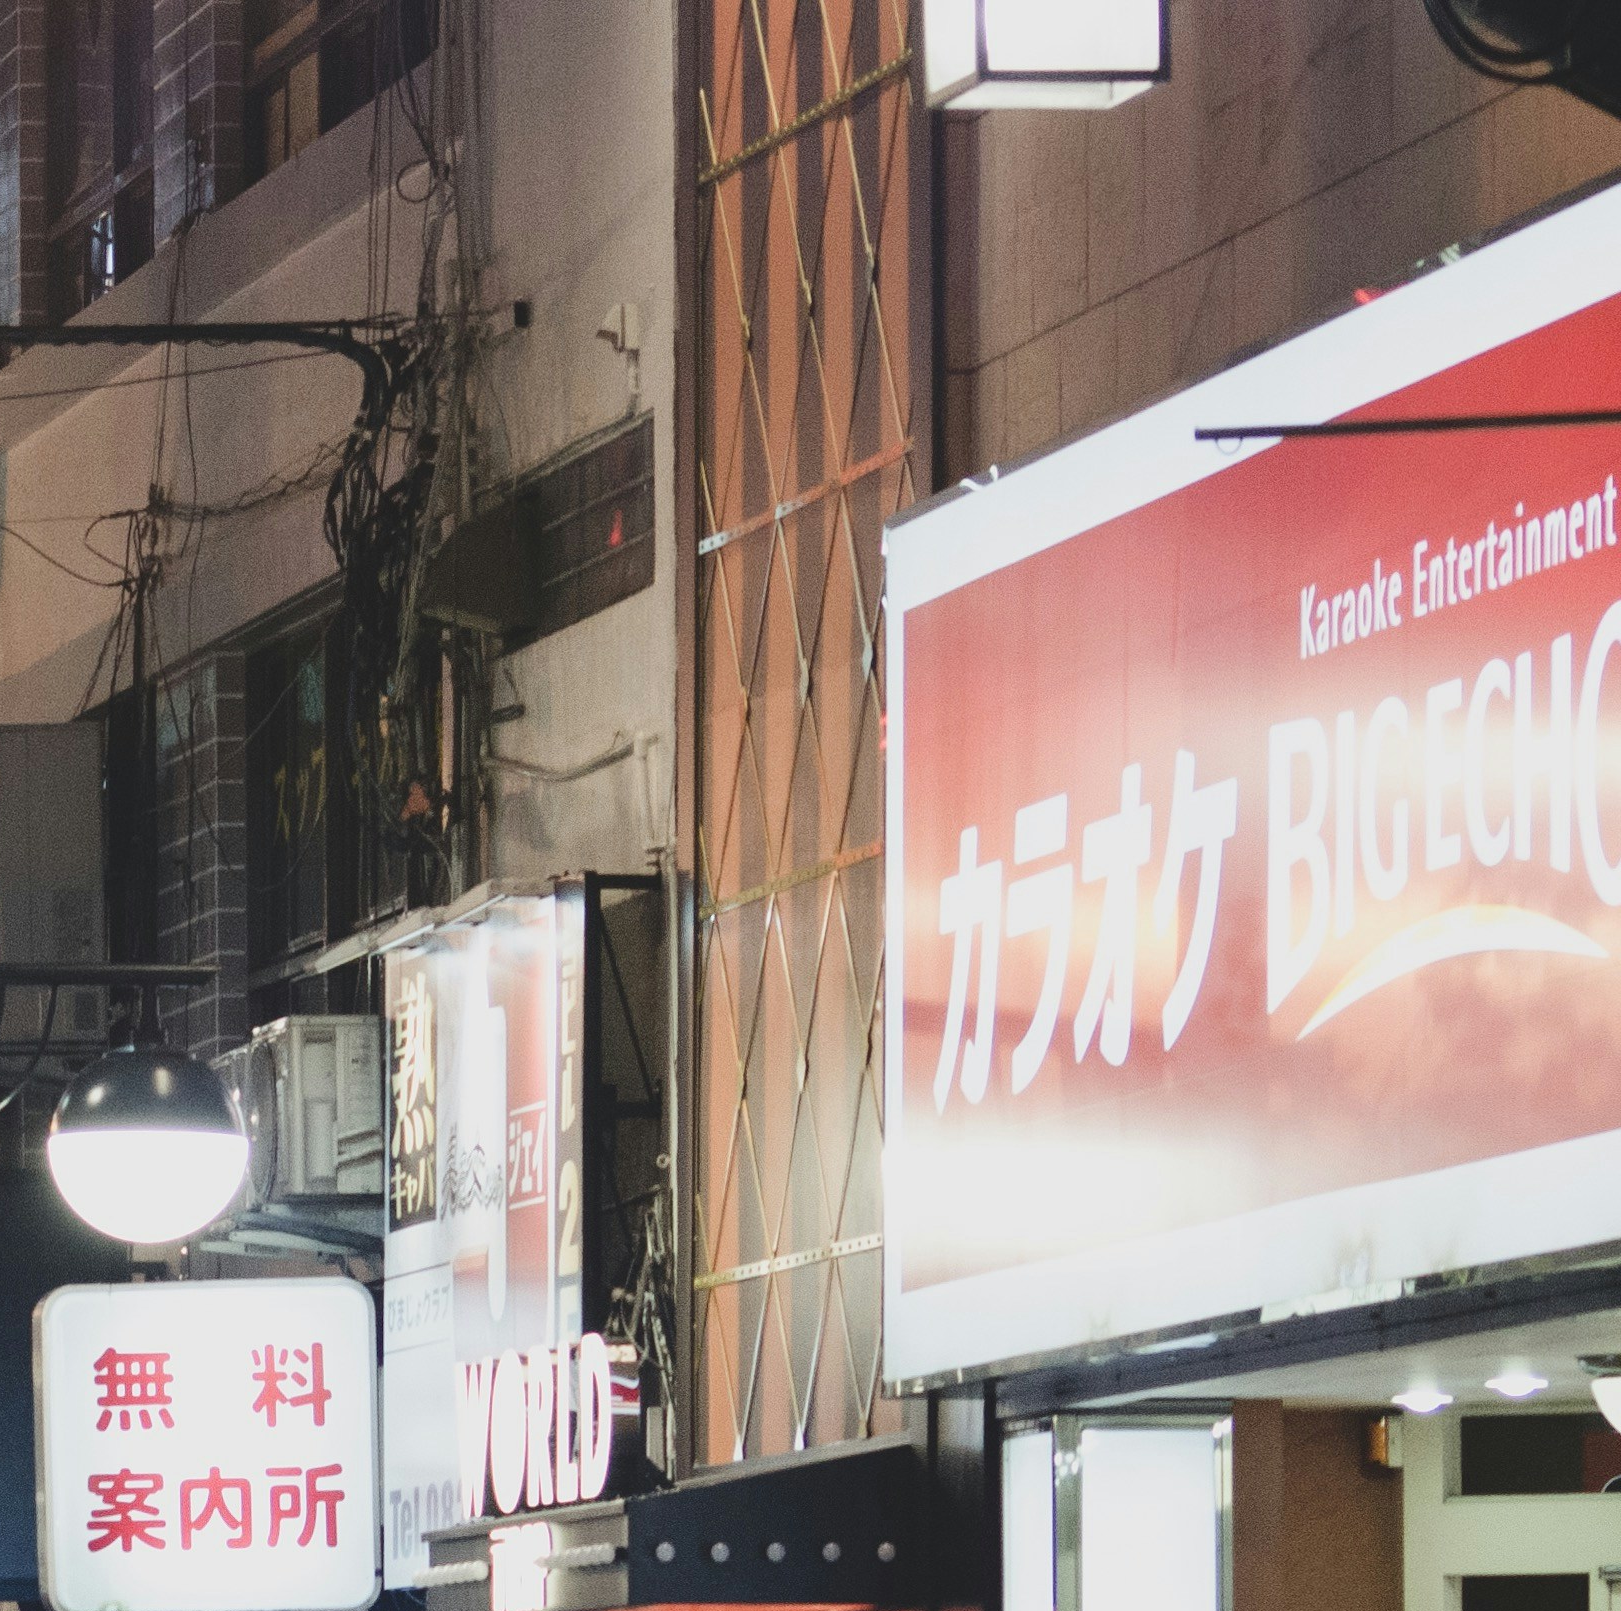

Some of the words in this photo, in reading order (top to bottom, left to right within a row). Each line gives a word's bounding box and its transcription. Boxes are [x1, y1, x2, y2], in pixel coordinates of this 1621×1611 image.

[1299, 558, 1402, 661] Karaoke
[1412, 472, 1619, 618] Entertainment
[933, 747, 1238, 1116] カラオケ
[1266, 697, 1409, 1015] BIG
[92, 1341, 333, 1433] 無料
[457, 1332, 613, 1521] WORLD
[86, 1462, 346, 1553] 案内所
